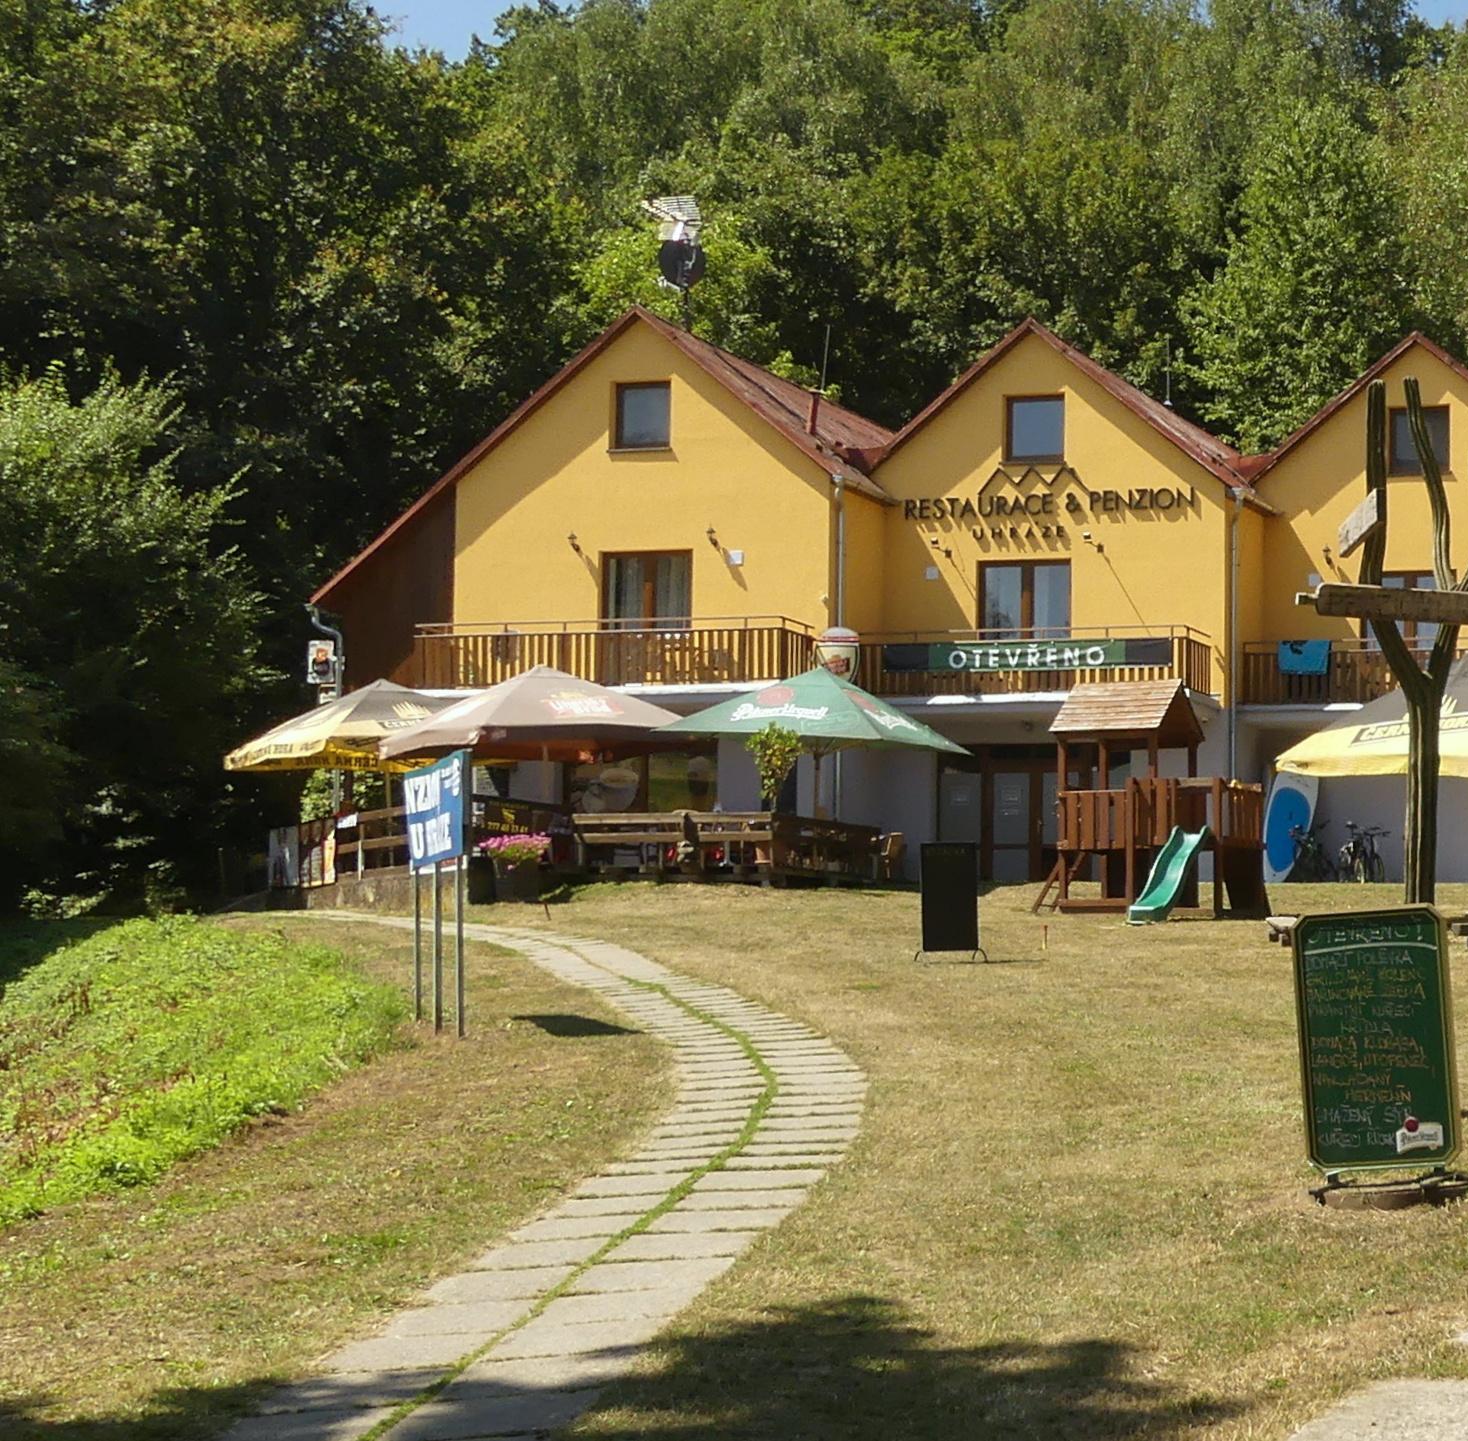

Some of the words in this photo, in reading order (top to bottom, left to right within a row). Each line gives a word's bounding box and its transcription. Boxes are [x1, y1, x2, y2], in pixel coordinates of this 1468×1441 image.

[904, 493, 1053, 520] RESTAURACE
[1065, 491, 1082, 514] &
[1089, 486, 1195, 510] PENZION
[949, 644, 1105, 669] OTEVŘENO
